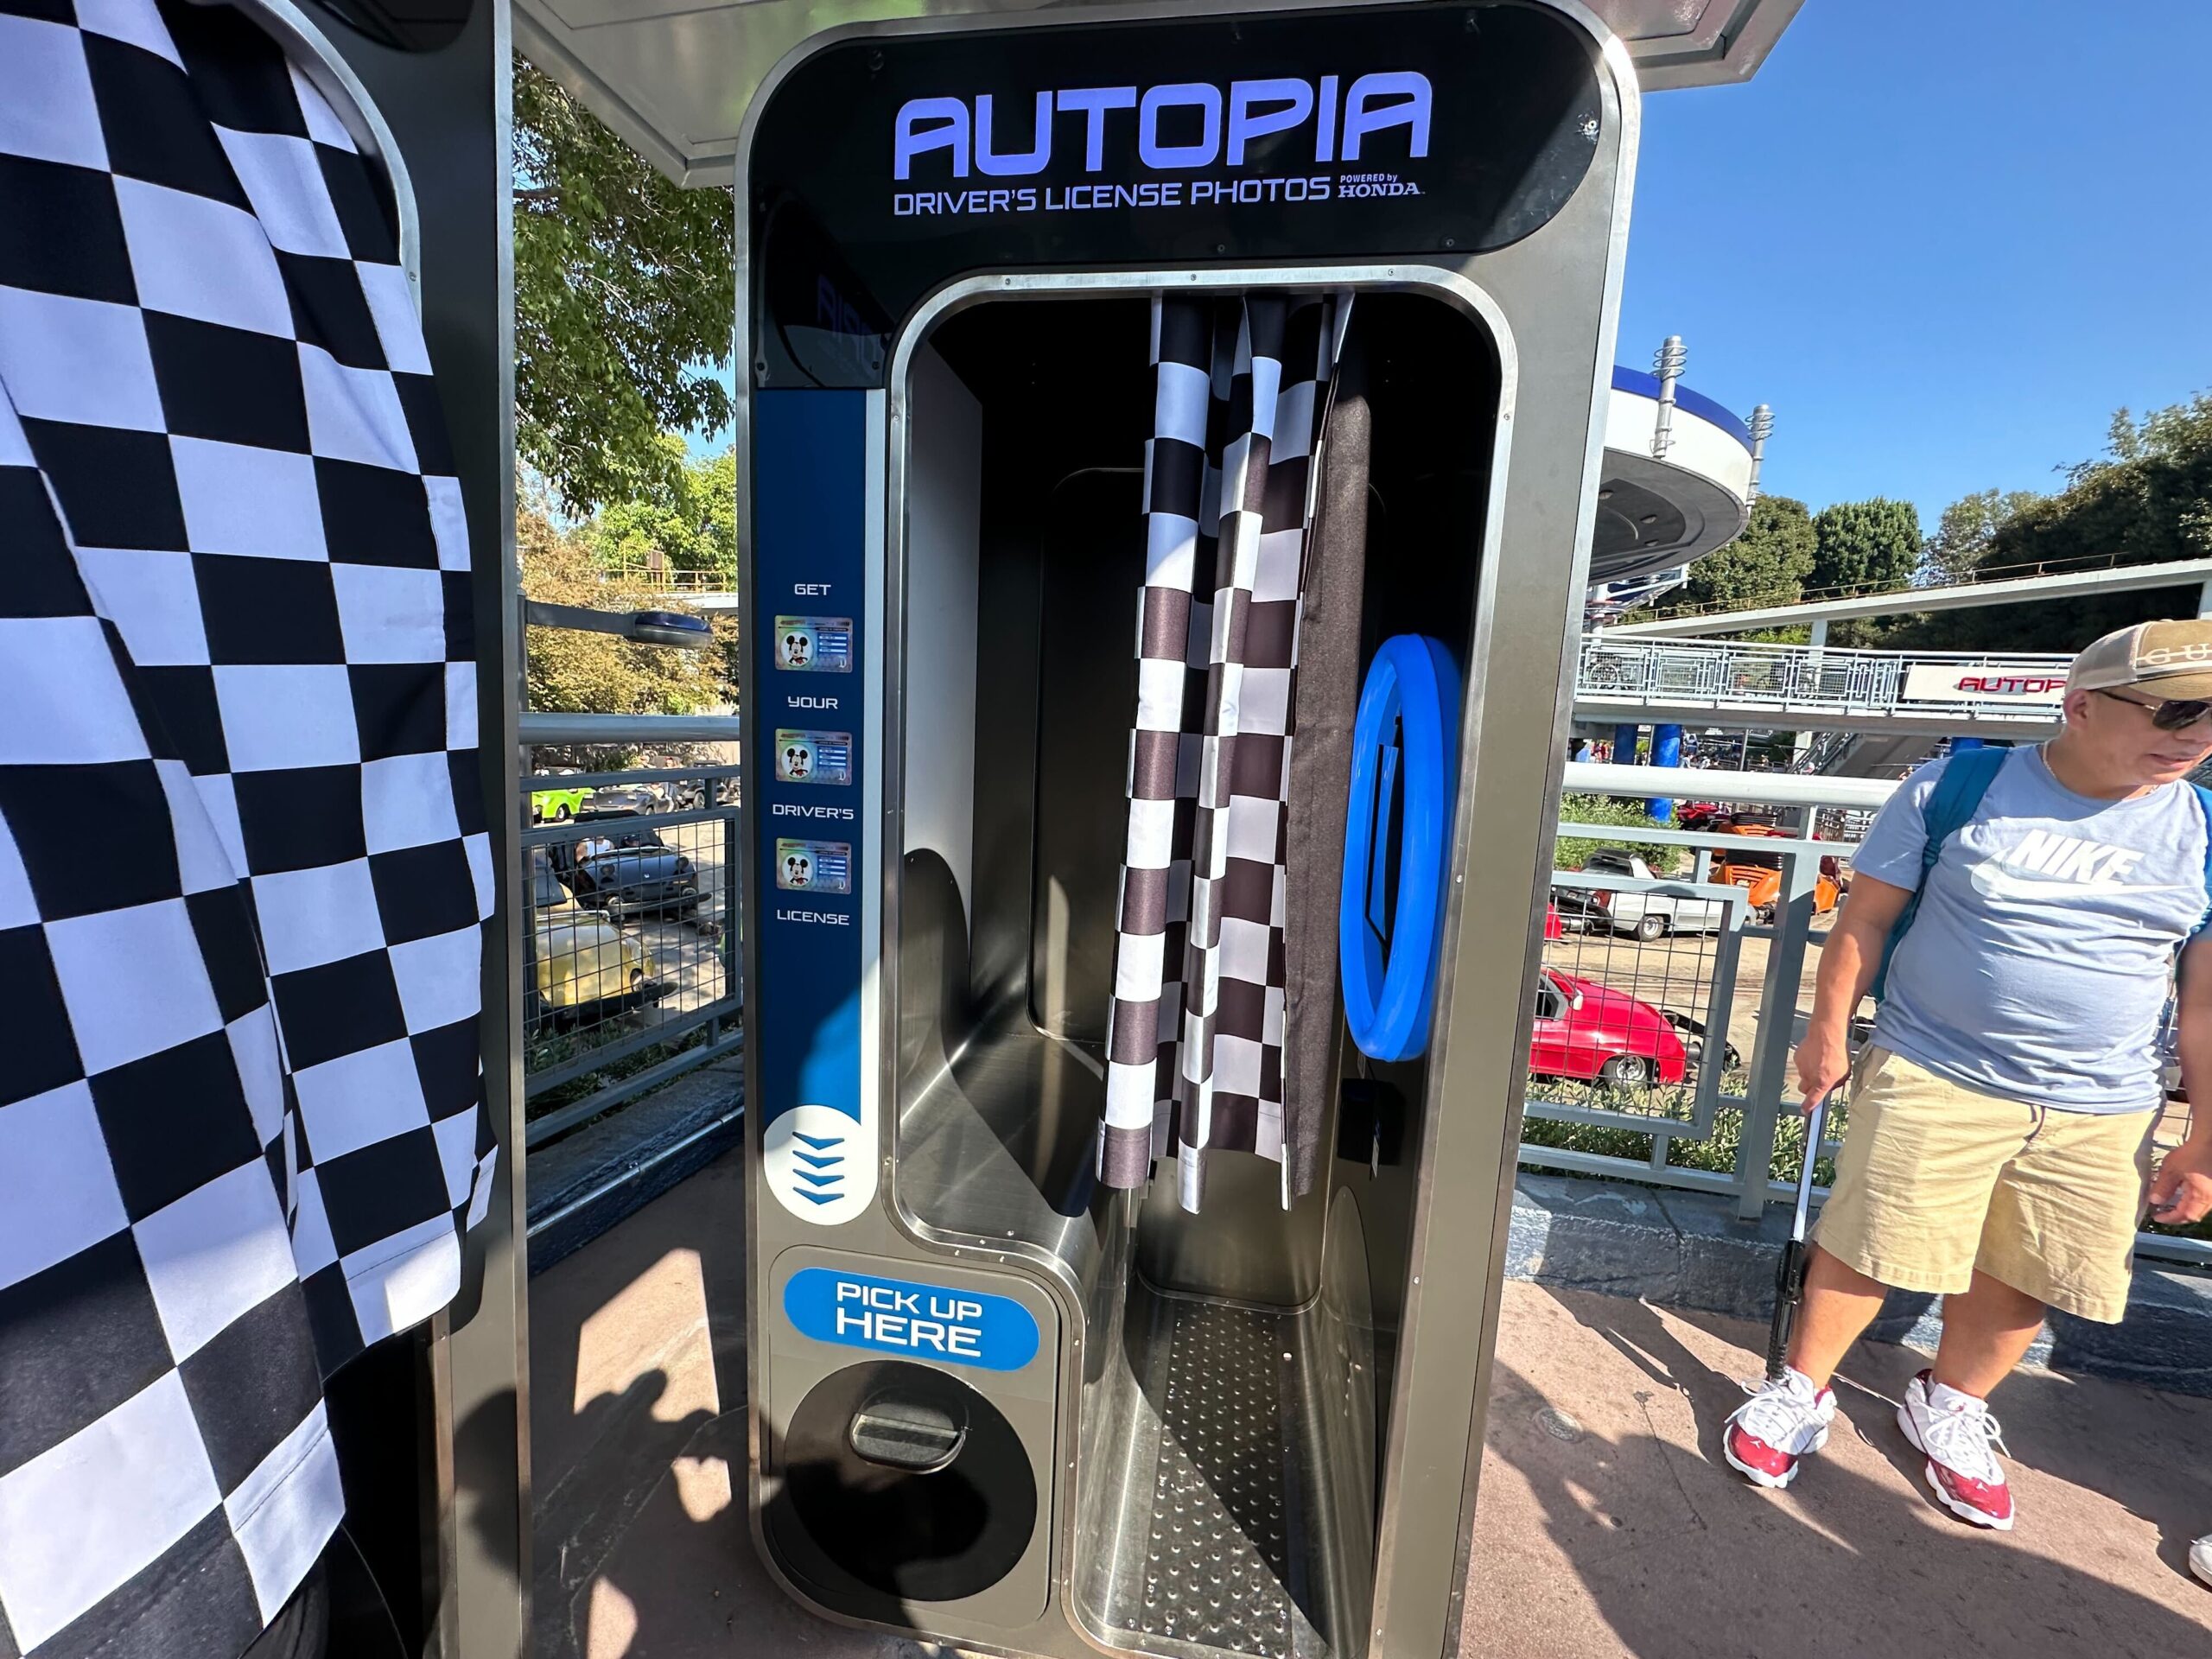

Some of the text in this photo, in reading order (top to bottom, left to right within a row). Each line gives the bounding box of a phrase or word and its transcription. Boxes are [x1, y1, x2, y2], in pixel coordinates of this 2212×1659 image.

[894, 71, 1432, 180] AUTOPIA
[1340, 173, 1398, 183] POWERED by
[893, 176, 1332, 216] DRIVER'S LICENSE PHOTOS
[1337, 182, 1421, 198] HONDA
[793, 583, 832, 596] GET
[1958, 677, 2067, 694] AUTOP
[787, 696, 838, 710] YOUR
[772, 803, 855, 820] DRIVER'S
[2006, 829, 2146, 886] NIKE
[777, 908, 850, 925] LICENSE
[836, 1281, 982, 1321] PICK UP
[836, 1306, 982, 1357] HERE
